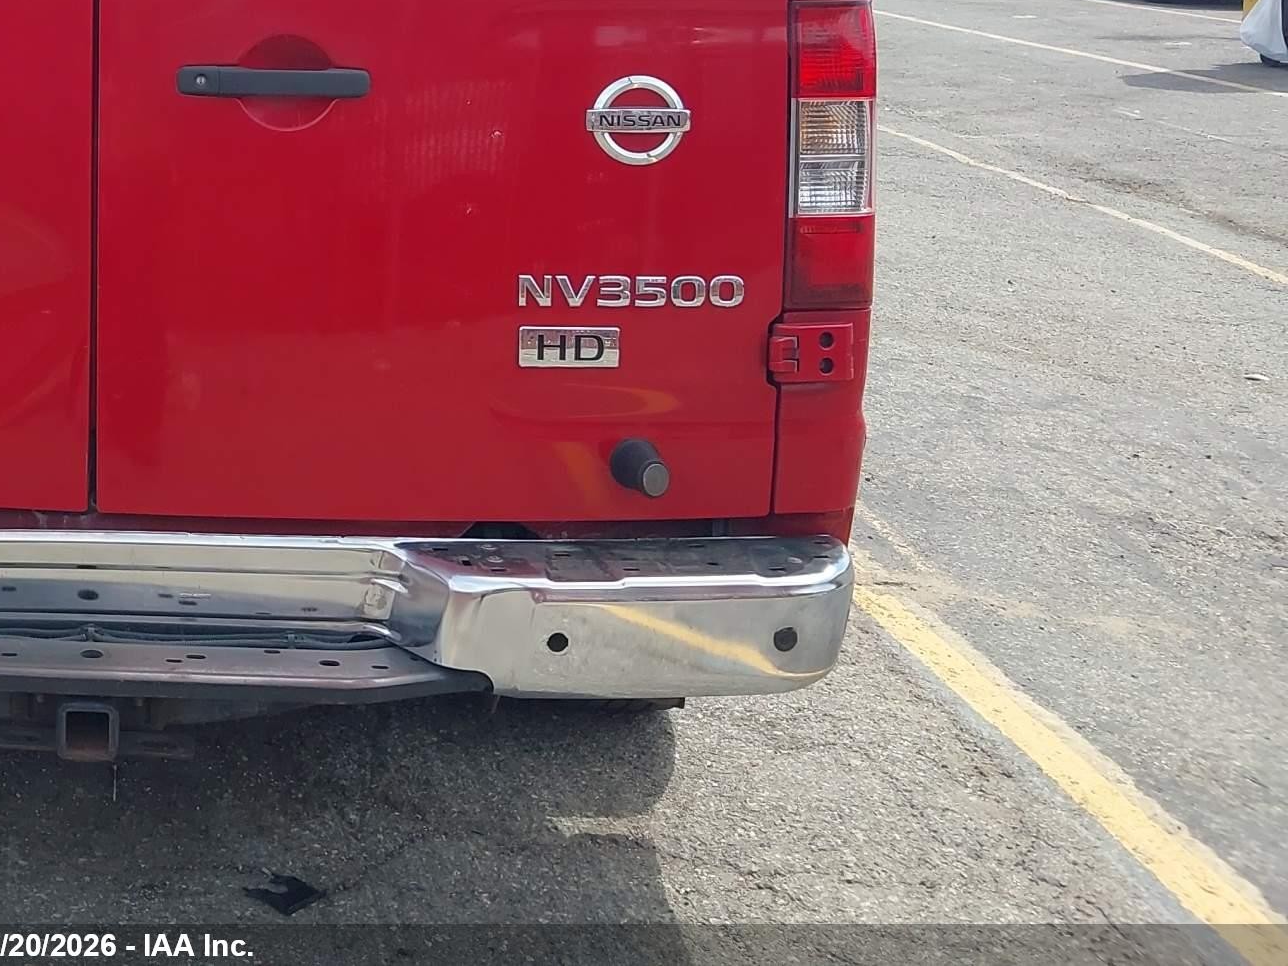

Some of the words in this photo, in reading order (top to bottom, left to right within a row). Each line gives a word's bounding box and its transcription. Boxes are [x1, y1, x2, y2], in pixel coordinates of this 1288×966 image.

[599, 114, 681, 127] NISSAN
[518, 274, 745, 307] NV3500
[536, 334, 605, 361] HD
